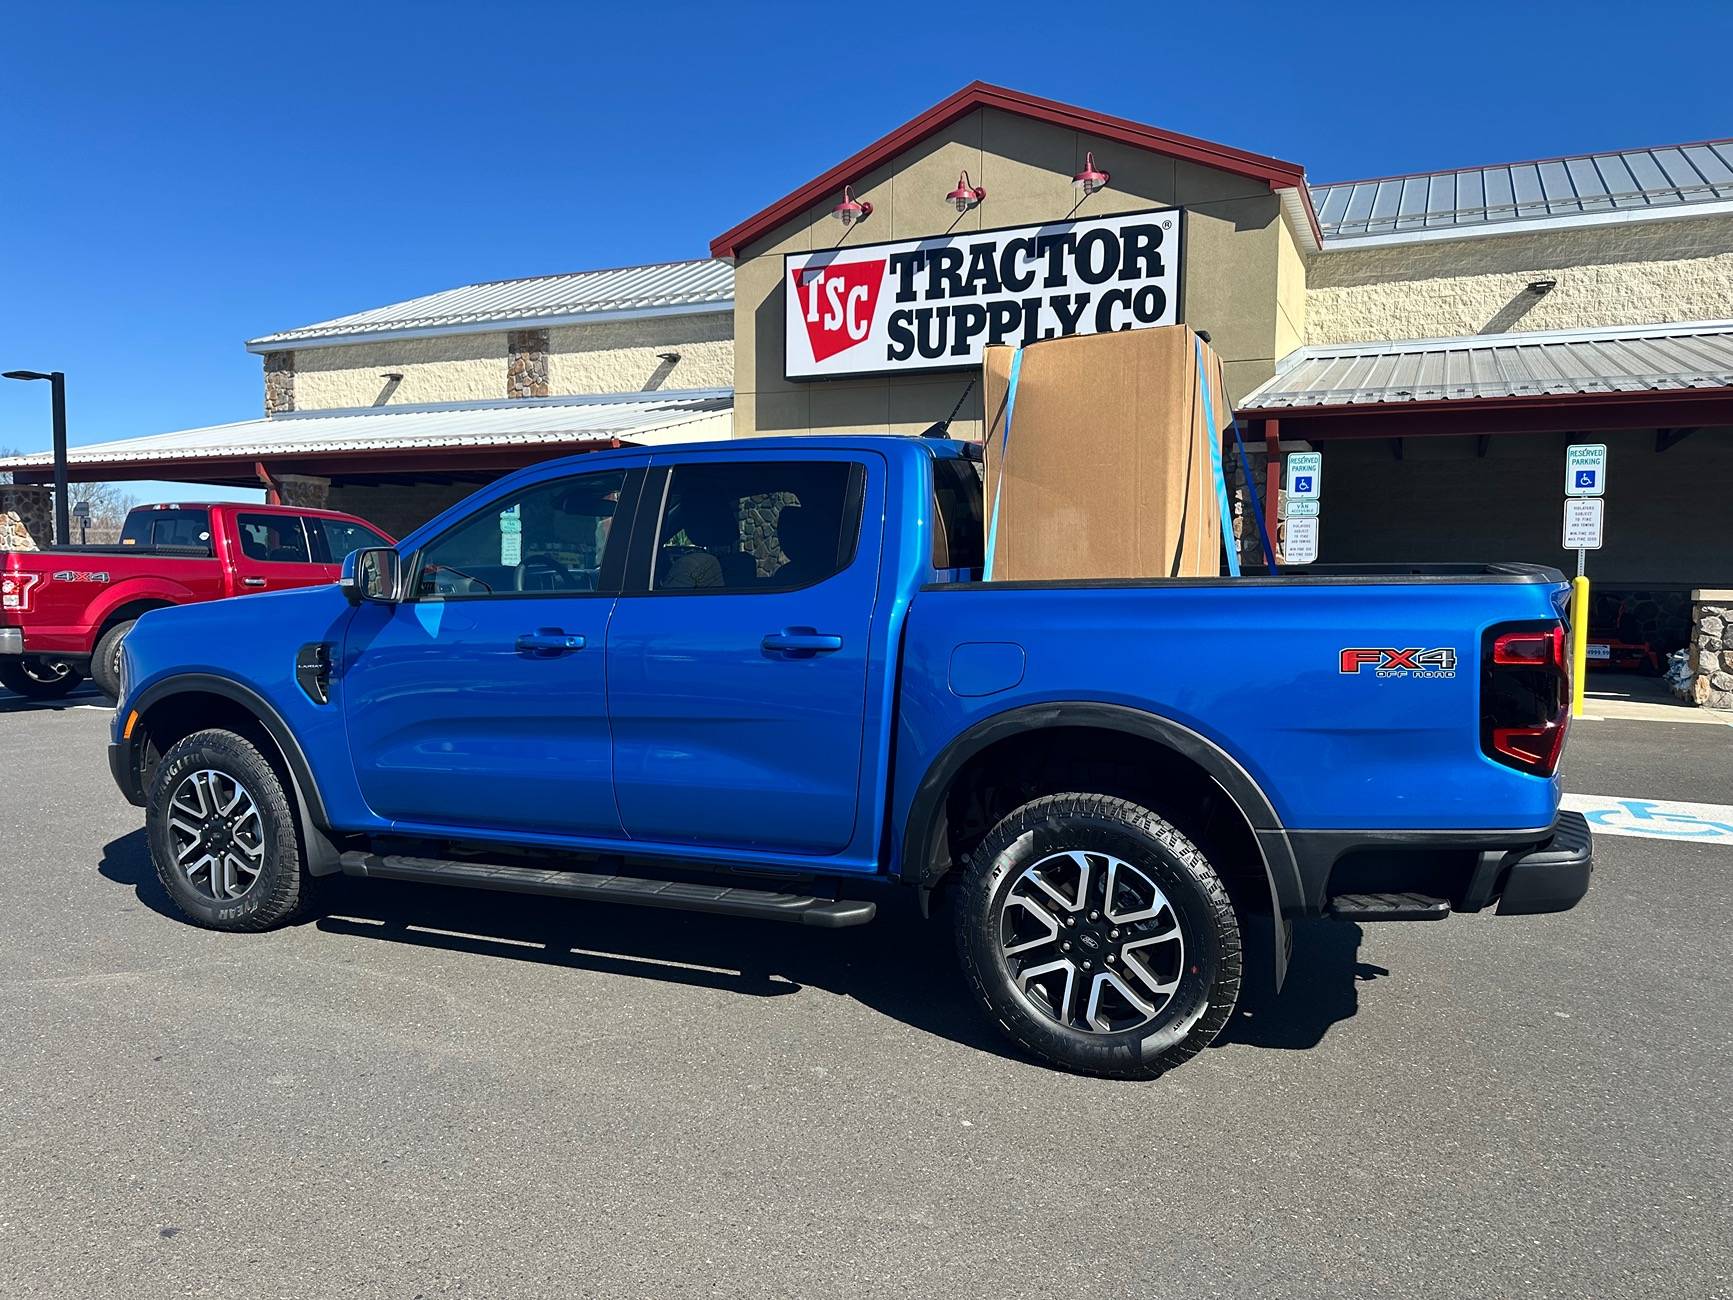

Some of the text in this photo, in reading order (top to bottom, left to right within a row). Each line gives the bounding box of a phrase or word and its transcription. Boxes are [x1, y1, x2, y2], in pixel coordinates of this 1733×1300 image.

[889, 223, 1165, 303] TRACTOR
[802, 270, 869, 341] TSC
[886, 293, 1090, 361] SUPPLY
[1570, 449, 1603, 457] RESERVED
[1339, 648, 1457, 674] FX4
